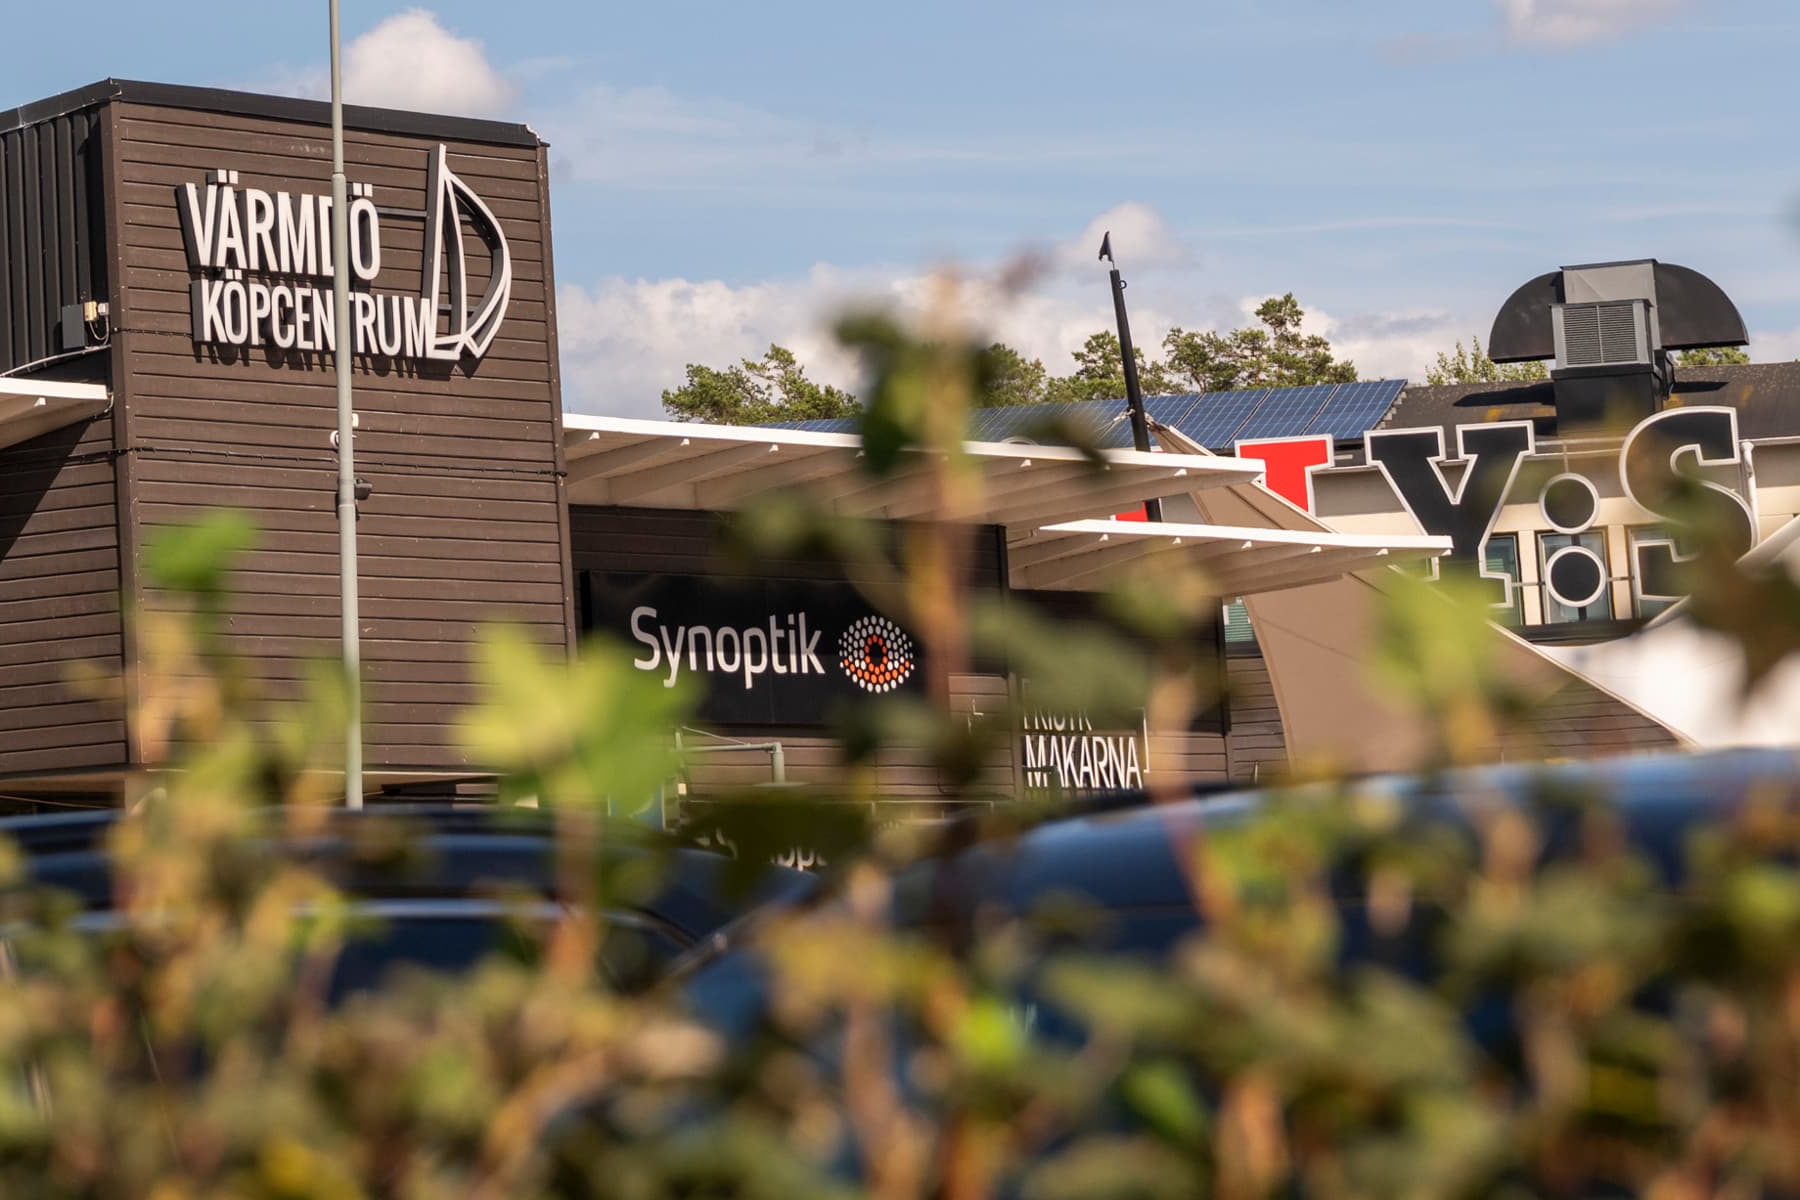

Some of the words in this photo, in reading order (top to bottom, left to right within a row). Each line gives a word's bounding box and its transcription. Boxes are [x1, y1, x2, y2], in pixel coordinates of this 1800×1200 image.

[199, 268, 436, 359] KÖPCENRUM
[631, 606, 826, 689] Synoptik
[1025, 734, 1143, 790] MAKARNA
